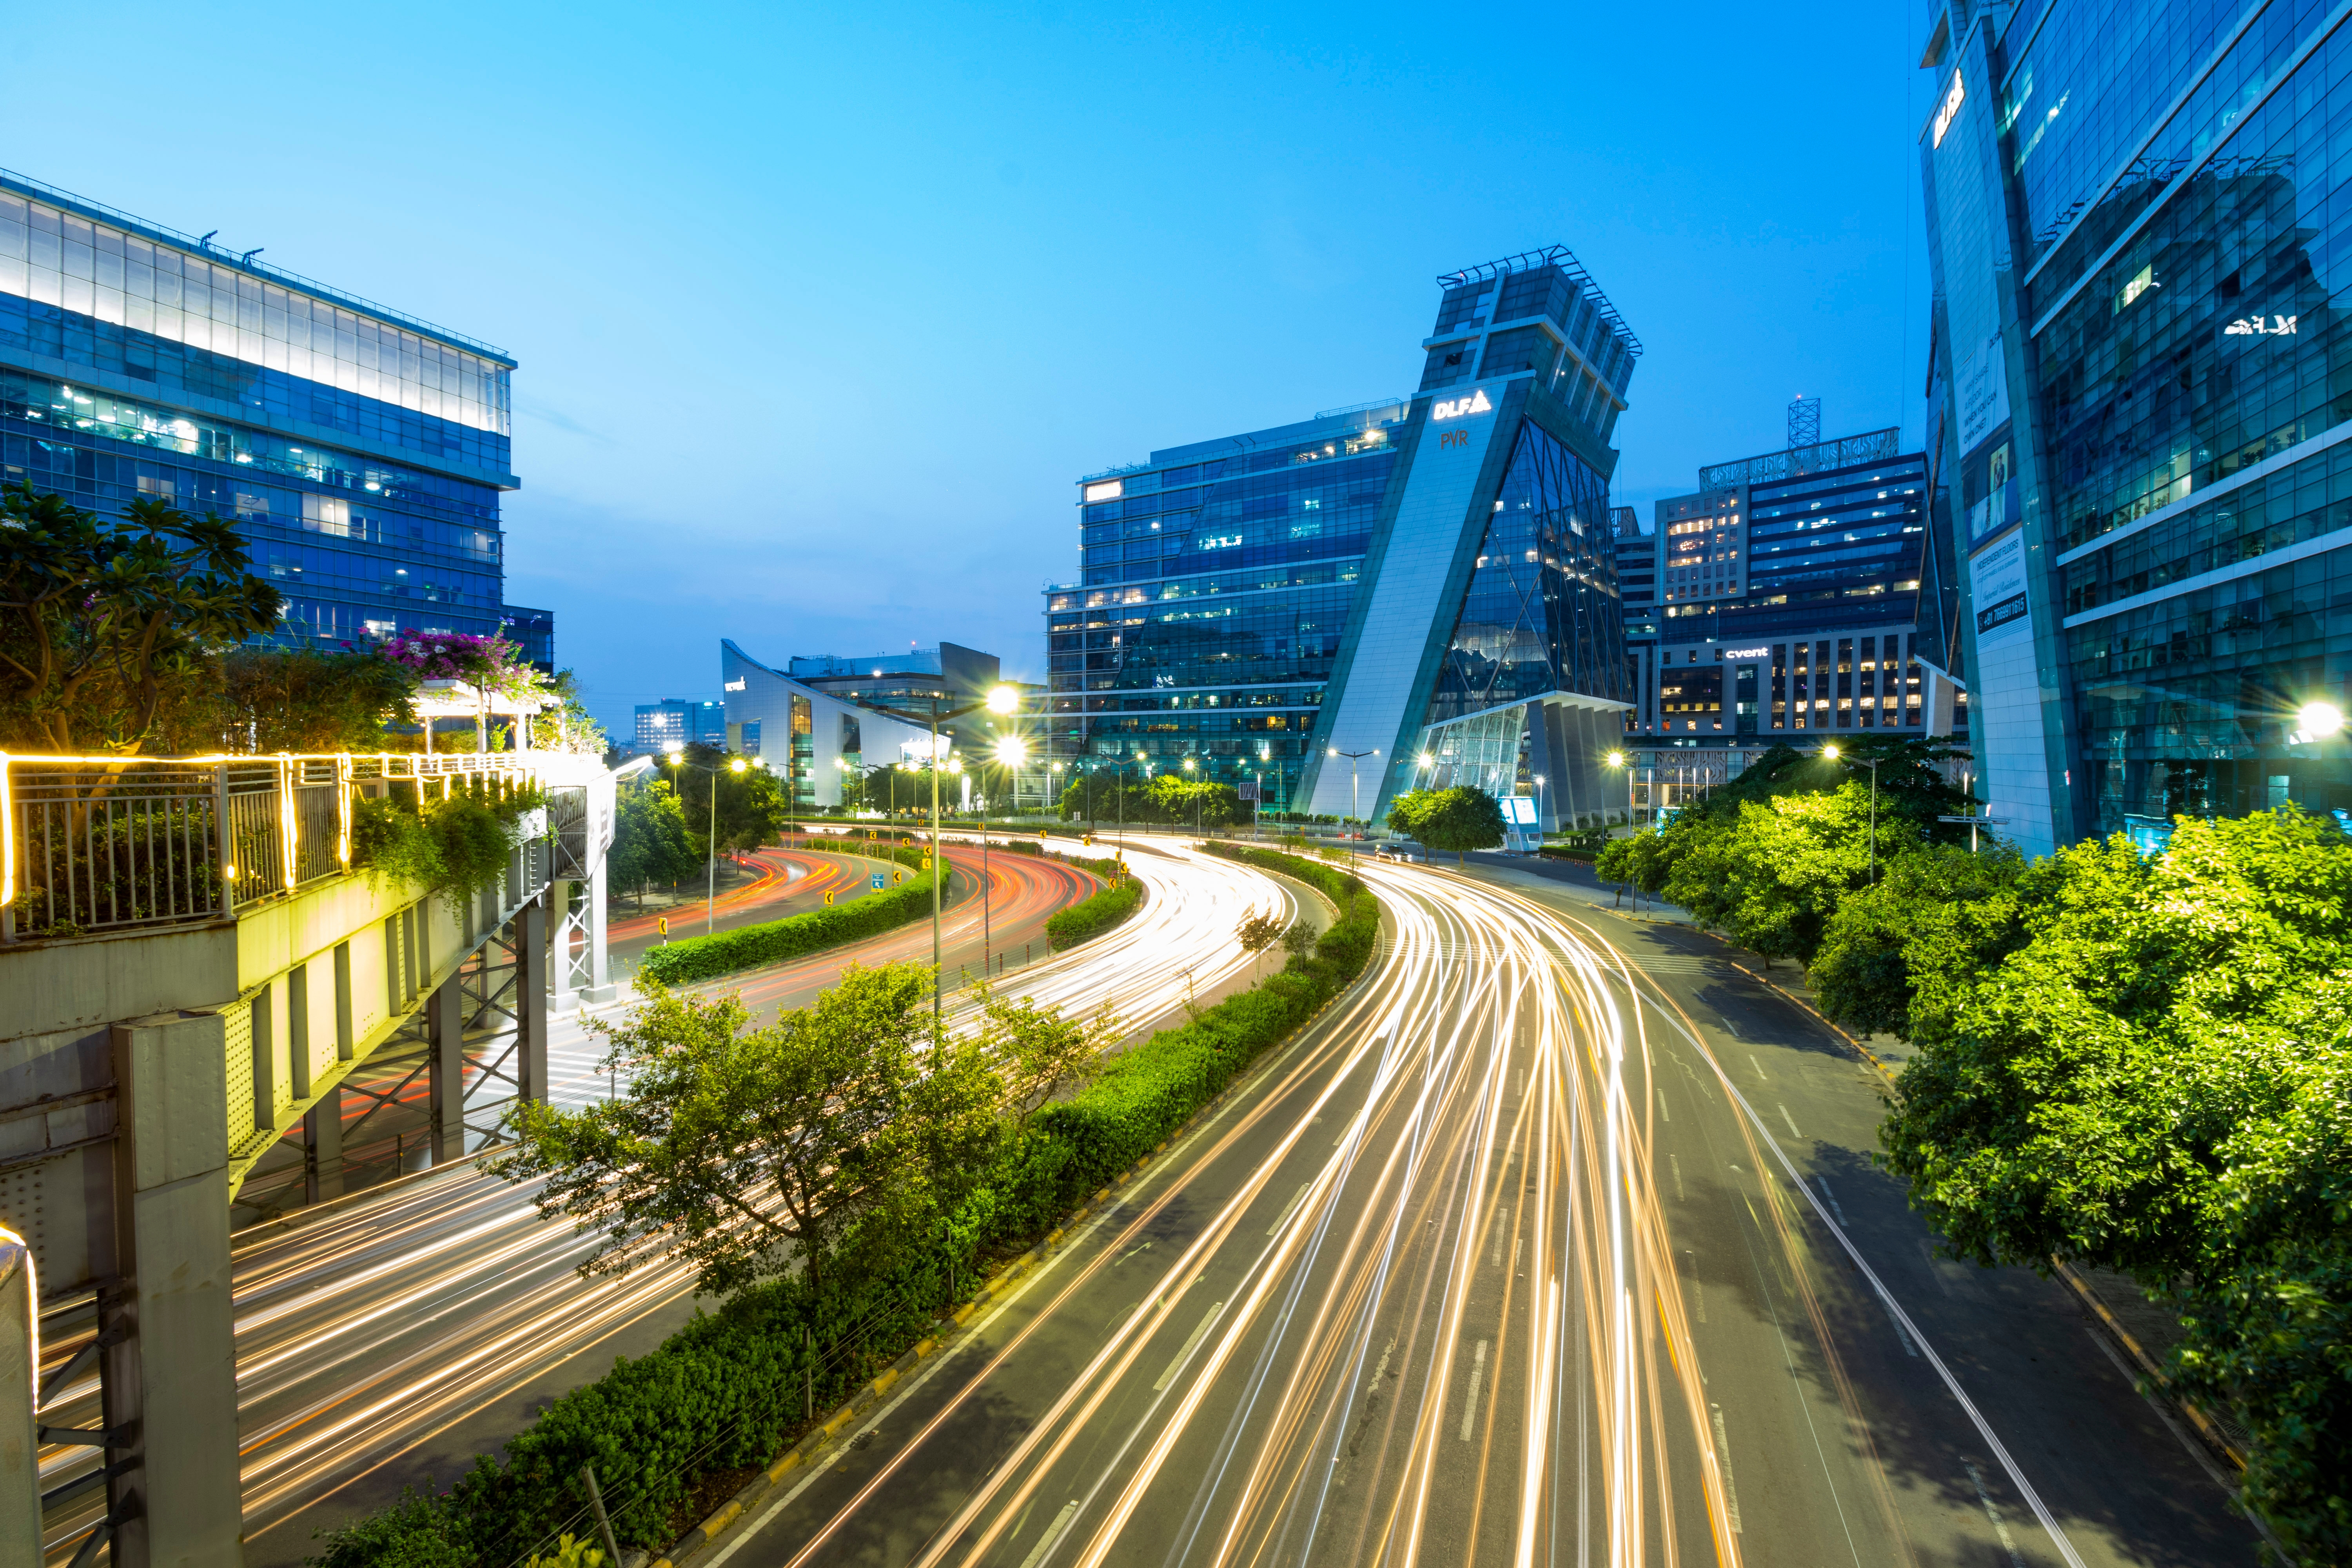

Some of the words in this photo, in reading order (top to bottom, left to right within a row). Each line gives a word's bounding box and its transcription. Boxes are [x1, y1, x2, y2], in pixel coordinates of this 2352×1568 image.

[1434, 398, 1472, 420] DLF
[1964, 408, 1977, 428] WHEN
[1978, 399, 1987, 415] YOU
[1987, 389, 1996, 405] CAN
[1441, 429, 1468, 450] PVR
[1964, 428, 1975, 444] OWN
[1975, 417, 1986, 434] ONE?
[1977, 548, 2002, 572] INDEPENDENT
[2002, 538, 2018, 556] FLOORS
[1984, 611, 1993, 627] +91
[1994, 597, 2024, 622] 7669911615
[1726, 647, 1768, 659] cvent
